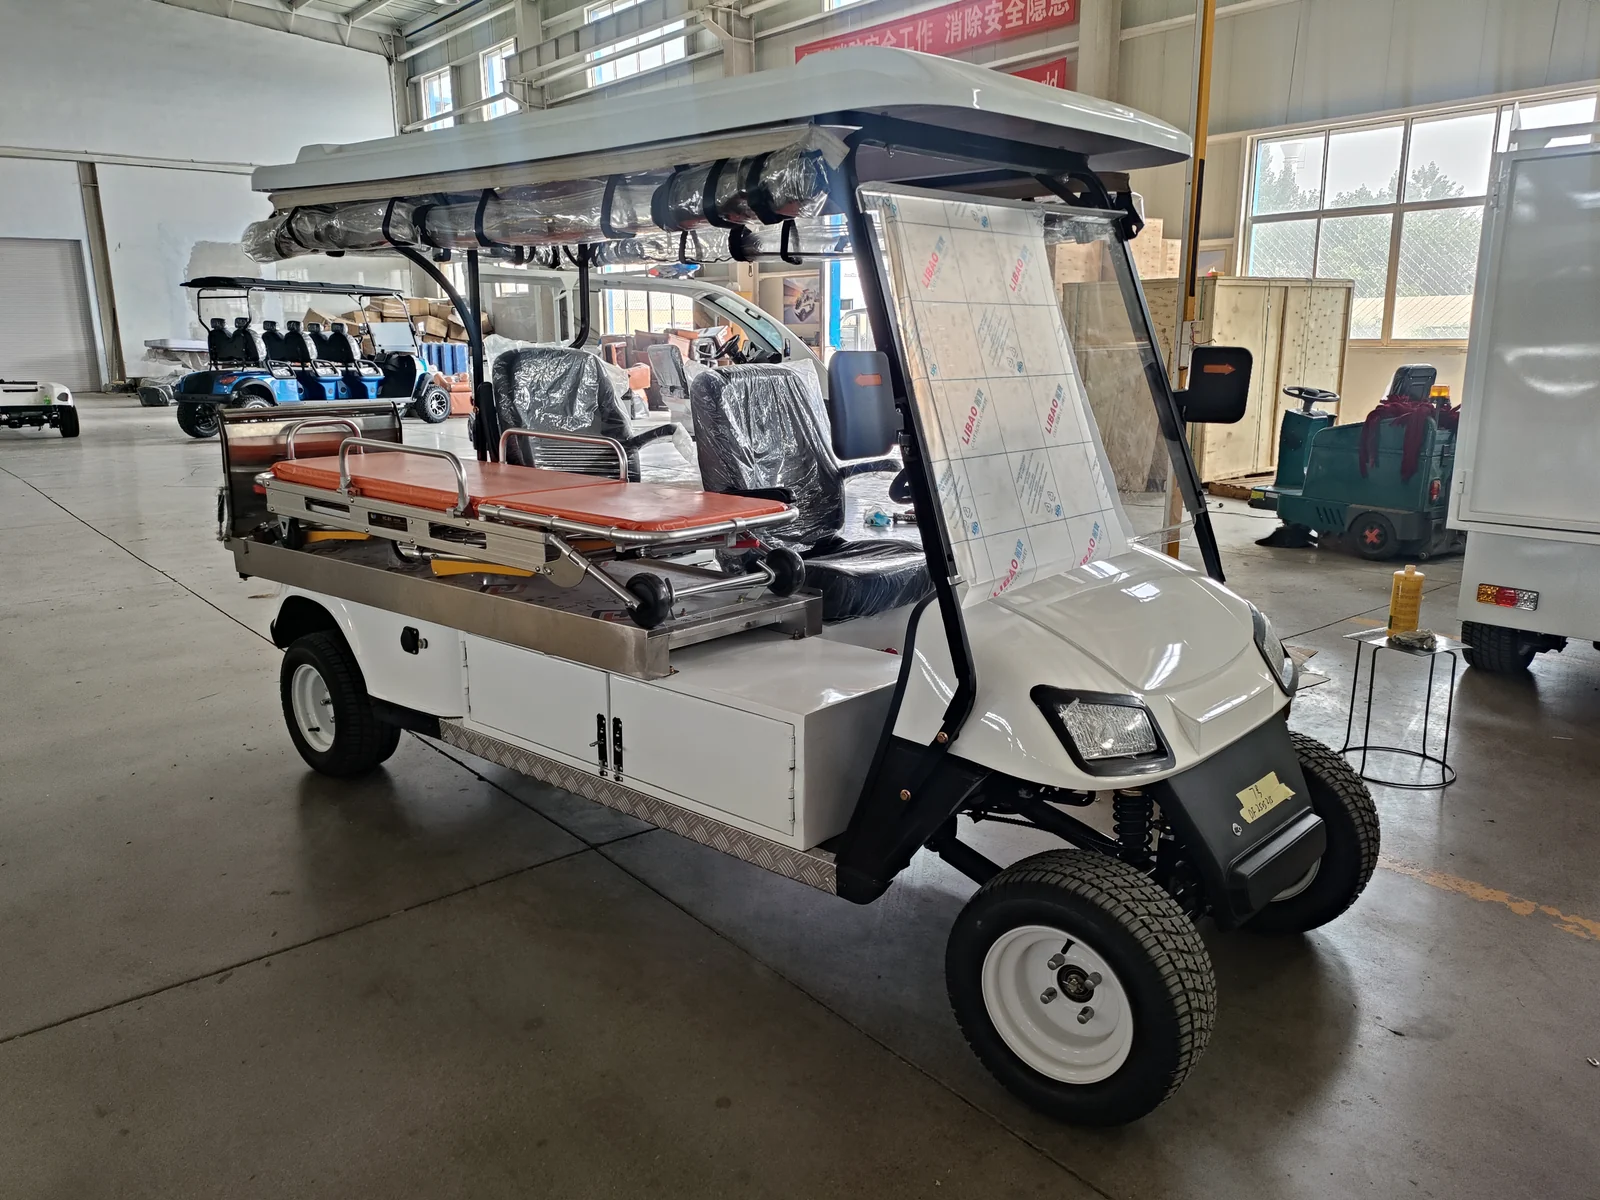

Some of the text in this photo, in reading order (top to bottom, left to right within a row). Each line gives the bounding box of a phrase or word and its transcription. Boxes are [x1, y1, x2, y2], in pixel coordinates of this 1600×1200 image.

[921, 252, 939, 288] LIBAO
[1009, 258, 1024, 292] LIBAO
[962, 406, 978, 445] LIBAO
[1045, 398, 1058, 434] LIBAO
[993, 559, 1018, 597] LIBAO
